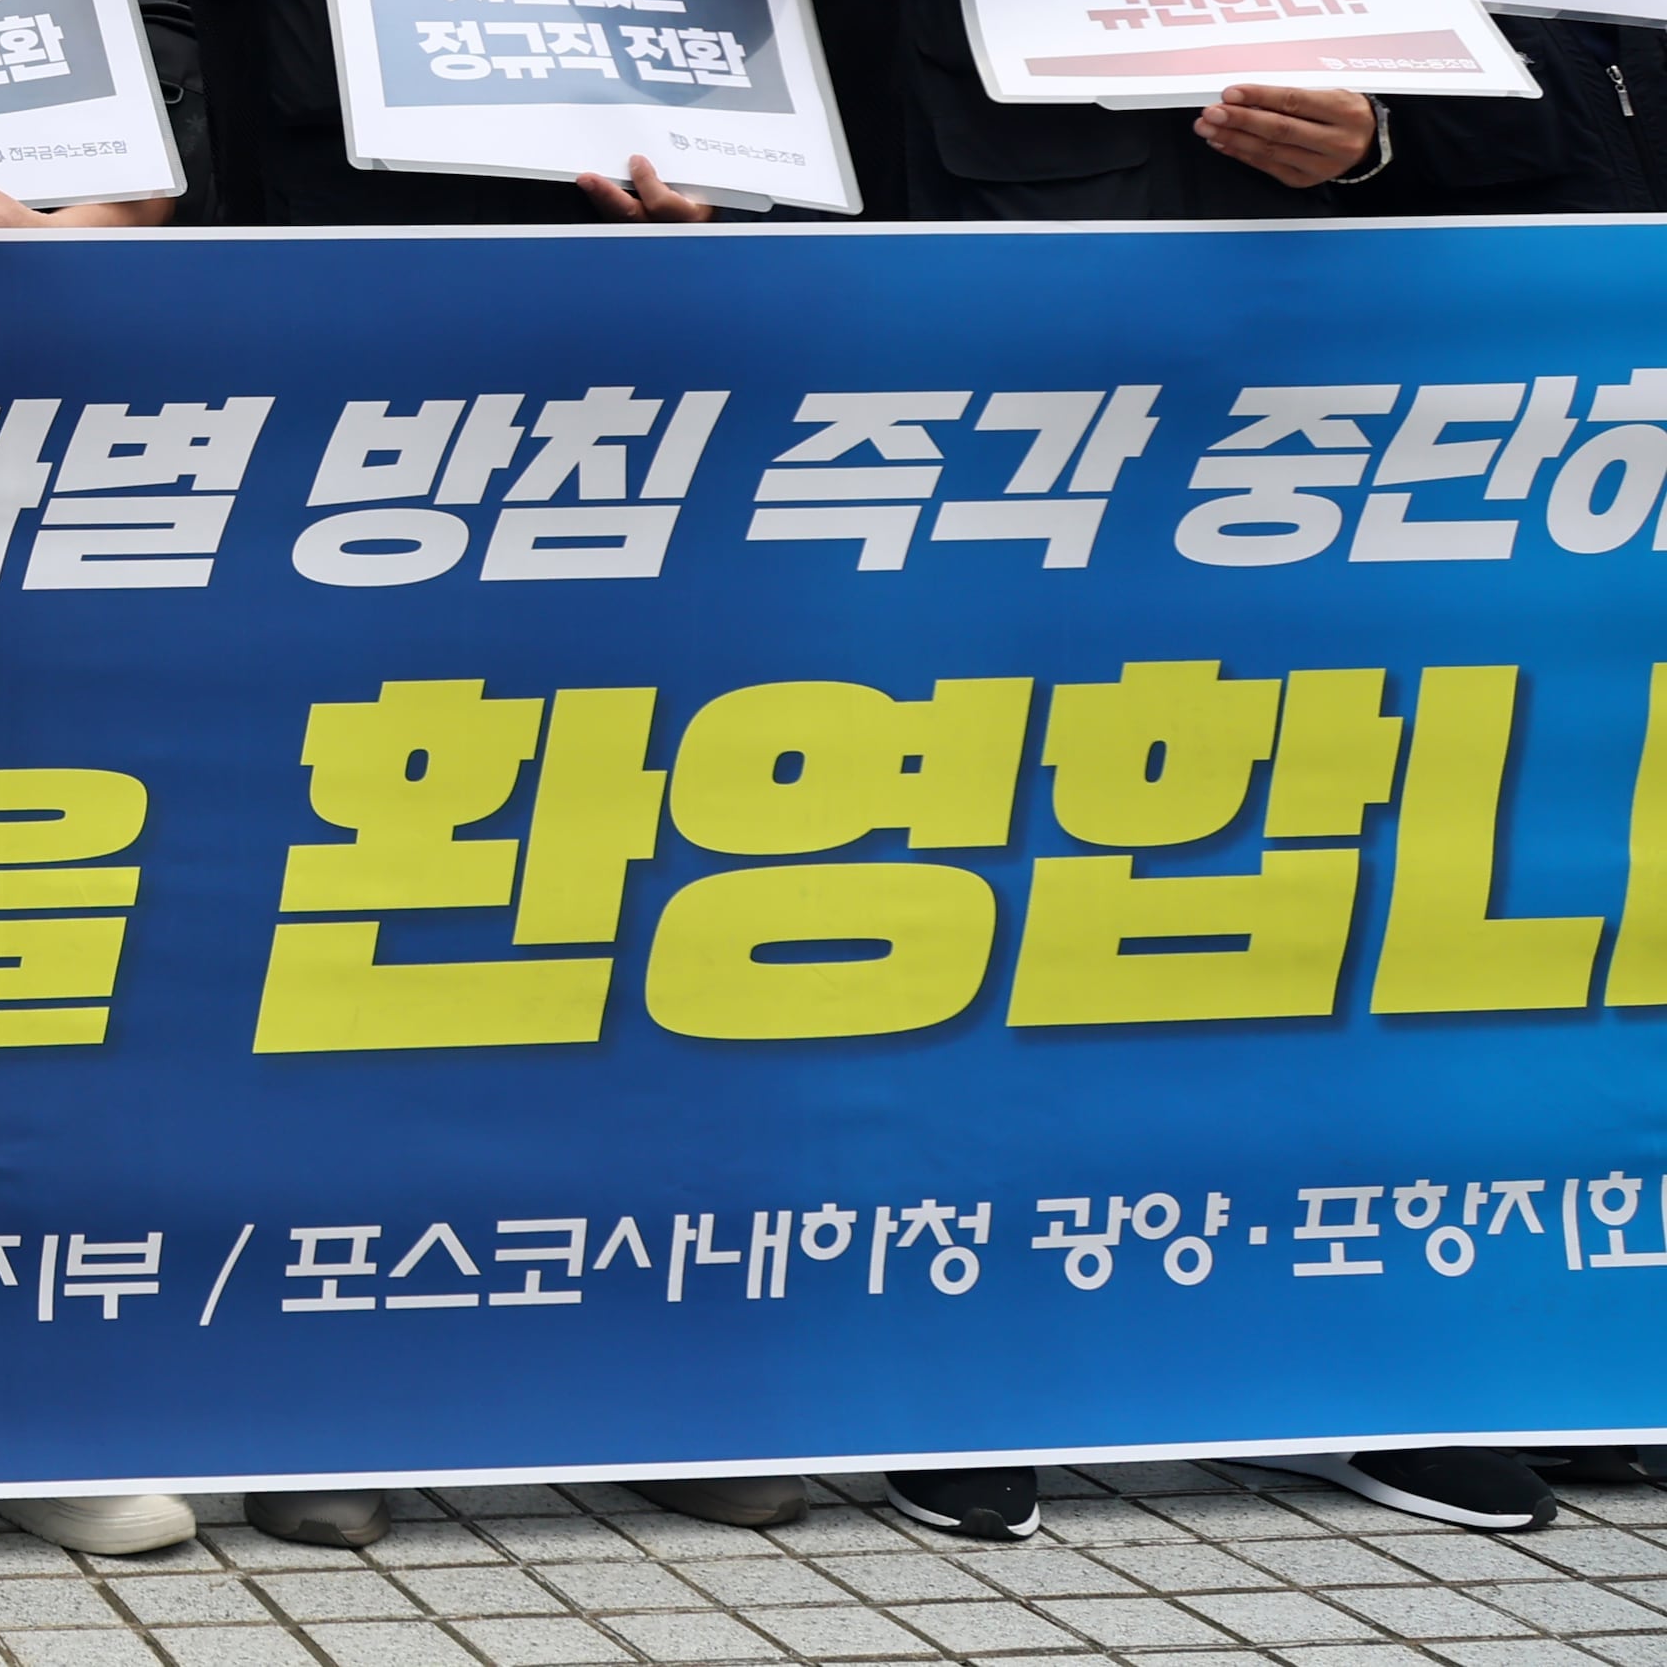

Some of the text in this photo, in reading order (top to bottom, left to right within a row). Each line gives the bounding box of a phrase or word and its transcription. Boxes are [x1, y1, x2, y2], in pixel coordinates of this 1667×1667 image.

[415, 20, 752, 88] 정규직 전환
[9, 140, 128, 162] 전국금속노동조합
[291, 386, 731, 587] 방침
[745, 384, 1162, 571] 즉각
[199, 1223, 255, 1326] /
[281, 1199, 992, 1312] 포스코사내하청
